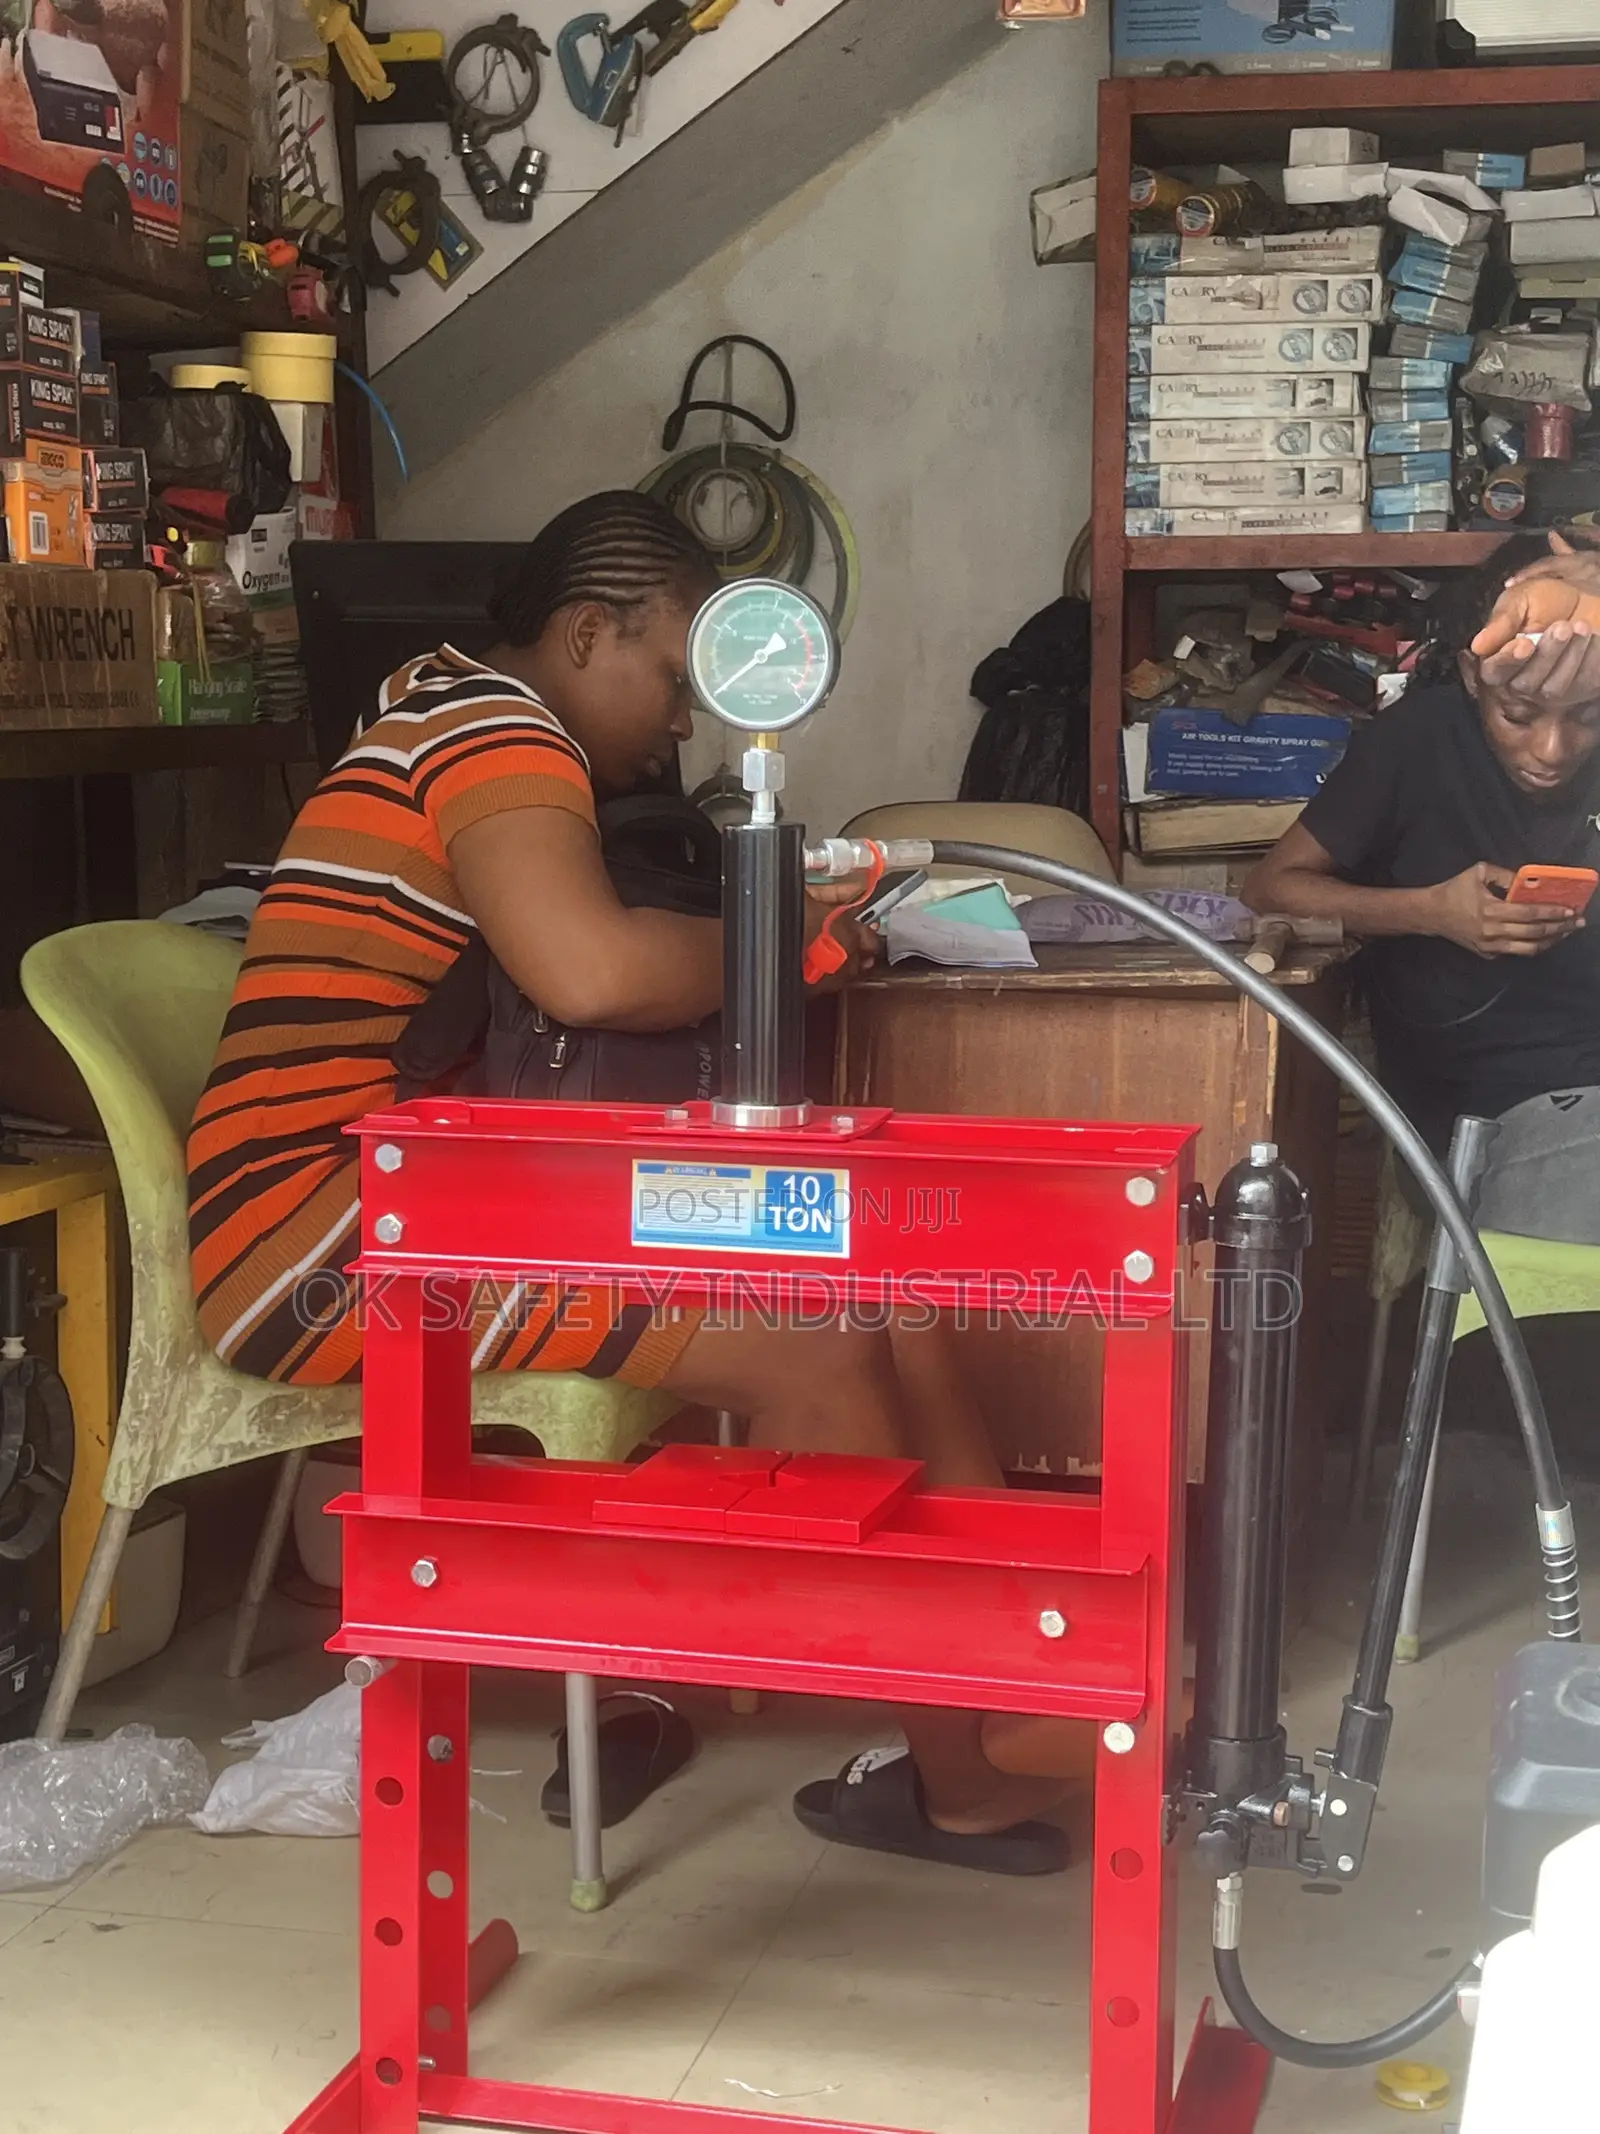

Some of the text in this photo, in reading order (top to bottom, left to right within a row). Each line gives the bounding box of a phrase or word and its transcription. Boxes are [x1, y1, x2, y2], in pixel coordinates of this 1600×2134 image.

[27, 605, 136, 662] WRENCH
[1280, 737, 1309, 747] SPRAY
[783, 1174, 821, 1205] 10
[767, 1206, 832, 1234] TON
